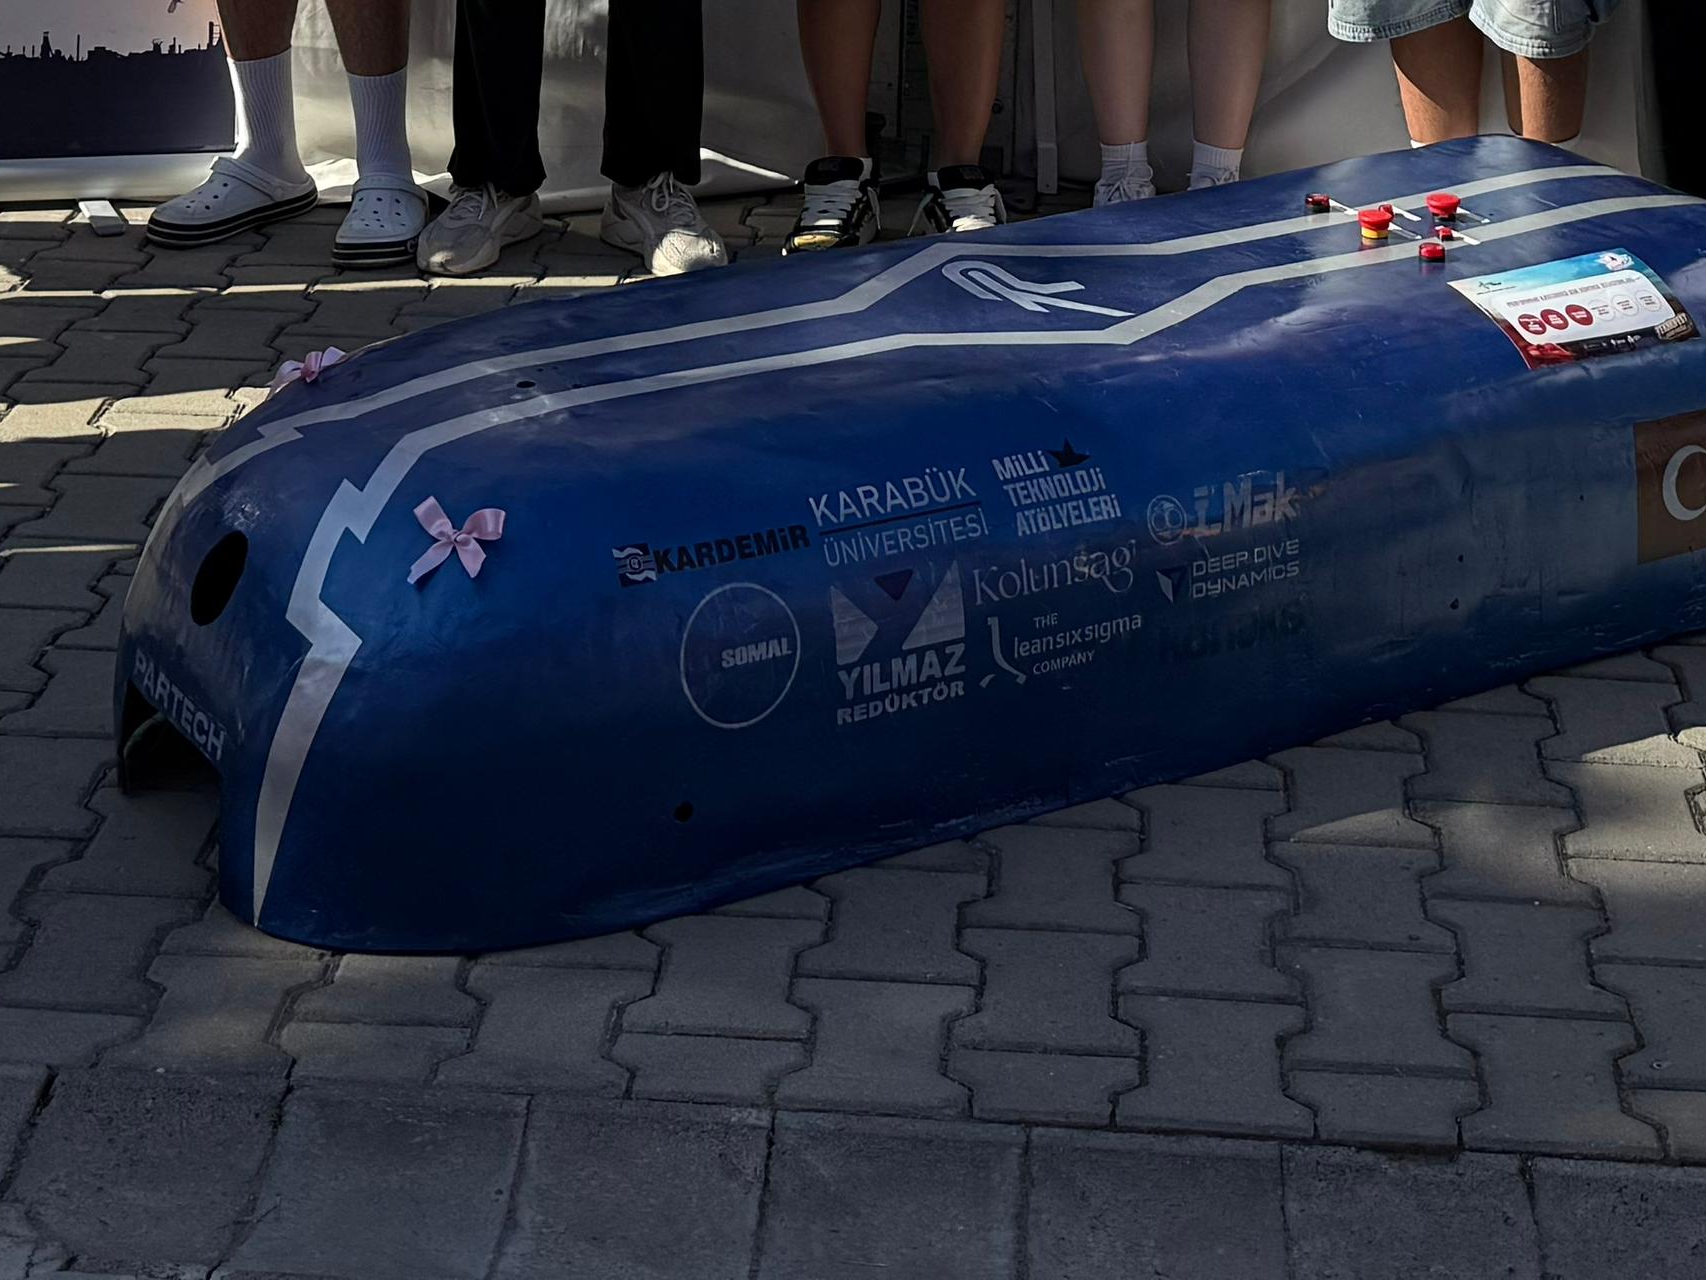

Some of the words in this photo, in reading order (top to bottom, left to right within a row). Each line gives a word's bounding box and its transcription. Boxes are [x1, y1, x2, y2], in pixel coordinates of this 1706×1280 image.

[808, 466, 977, 527] KARABÜK
[822, 507, 990, 568] ÜNİVERSİTESİ
[1193, 551, 1248, 577] DEEP
[1254, 538, 1300, 564] DIVE
[1193, 560, 1300, 599] DYNAMICS
[1033, 612, 1059, 630] THE
[721, 637, 792, 669] SOMAL
[837, 643, 966, 700] YILMAZ
[1032, 650, 1095, 675] COMPANY
[134, 648, 228, 761] PARTECH
[837, 680, 965, 726] REDÜKTÖR
